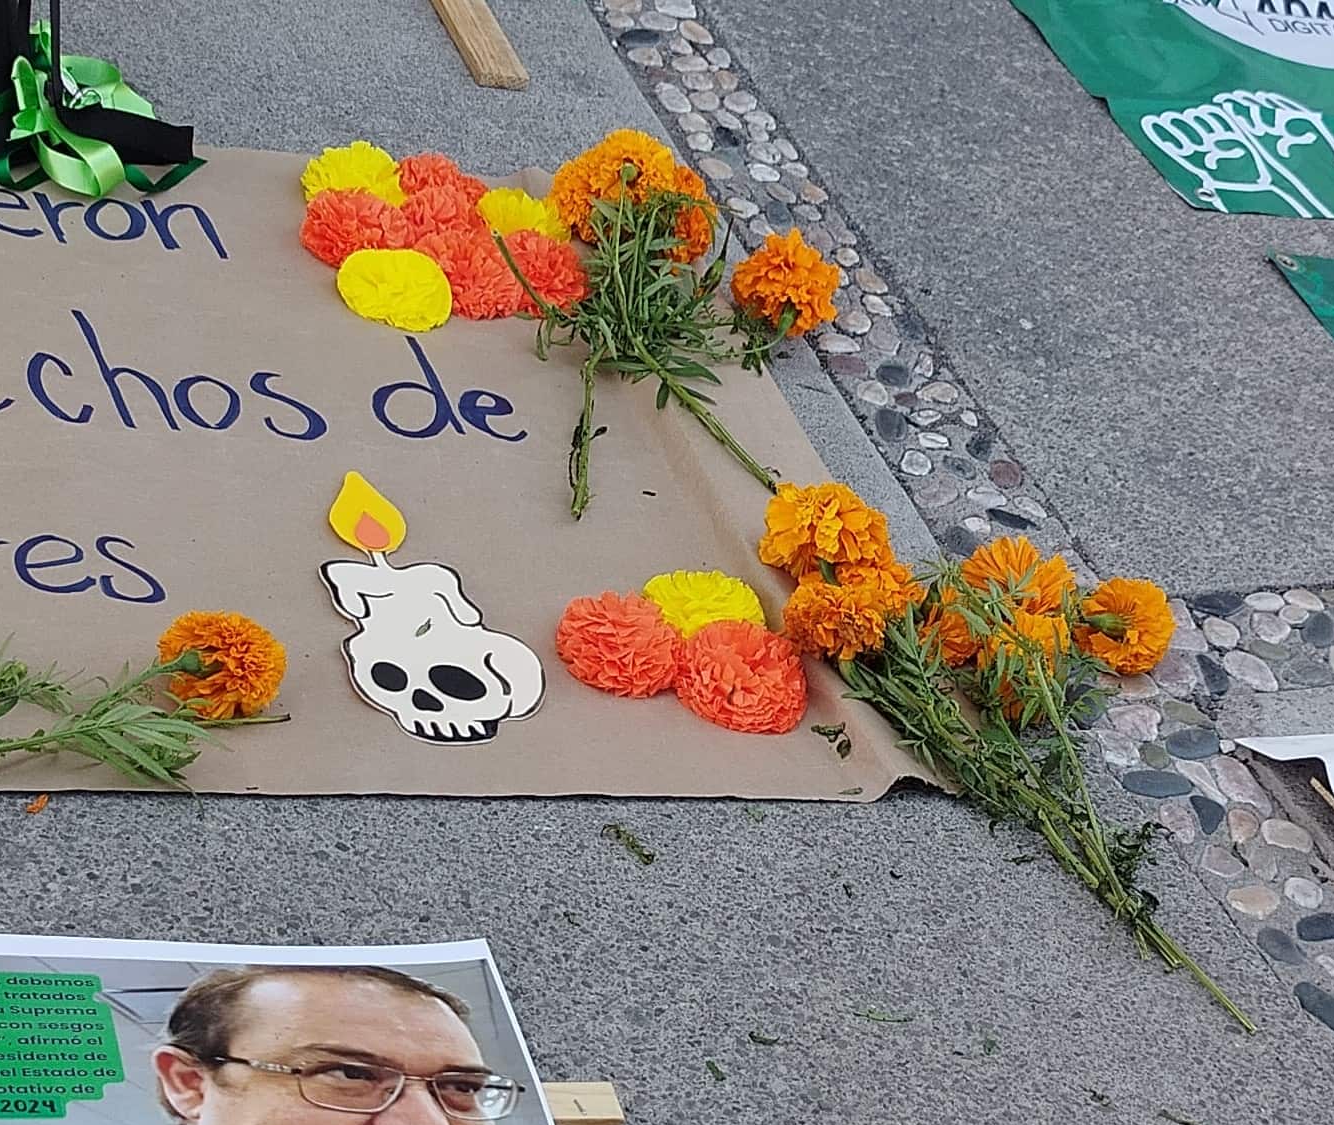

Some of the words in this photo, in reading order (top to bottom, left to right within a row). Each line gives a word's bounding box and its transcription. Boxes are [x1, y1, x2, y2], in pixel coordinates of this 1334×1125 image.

[371, 336, 529, 443] de
[6, 976, 95, 987] debemos
[4, 991, 86, 1001] tratados
[10, 1006, 97, 1017] Suprema
[38, 1021, 104, 1033] sesgos
[17, 1035, 82, 1045] afirmó
[87, 1036, 103, 1045] el
[84, 1052, 108, 1061] de
[22, 1068, 87, 1078] Estado
[93, 1068, 116, 1077] de
[71, 1085, 95, 1095] de
[0, 1099, 56, 1114] 2024
